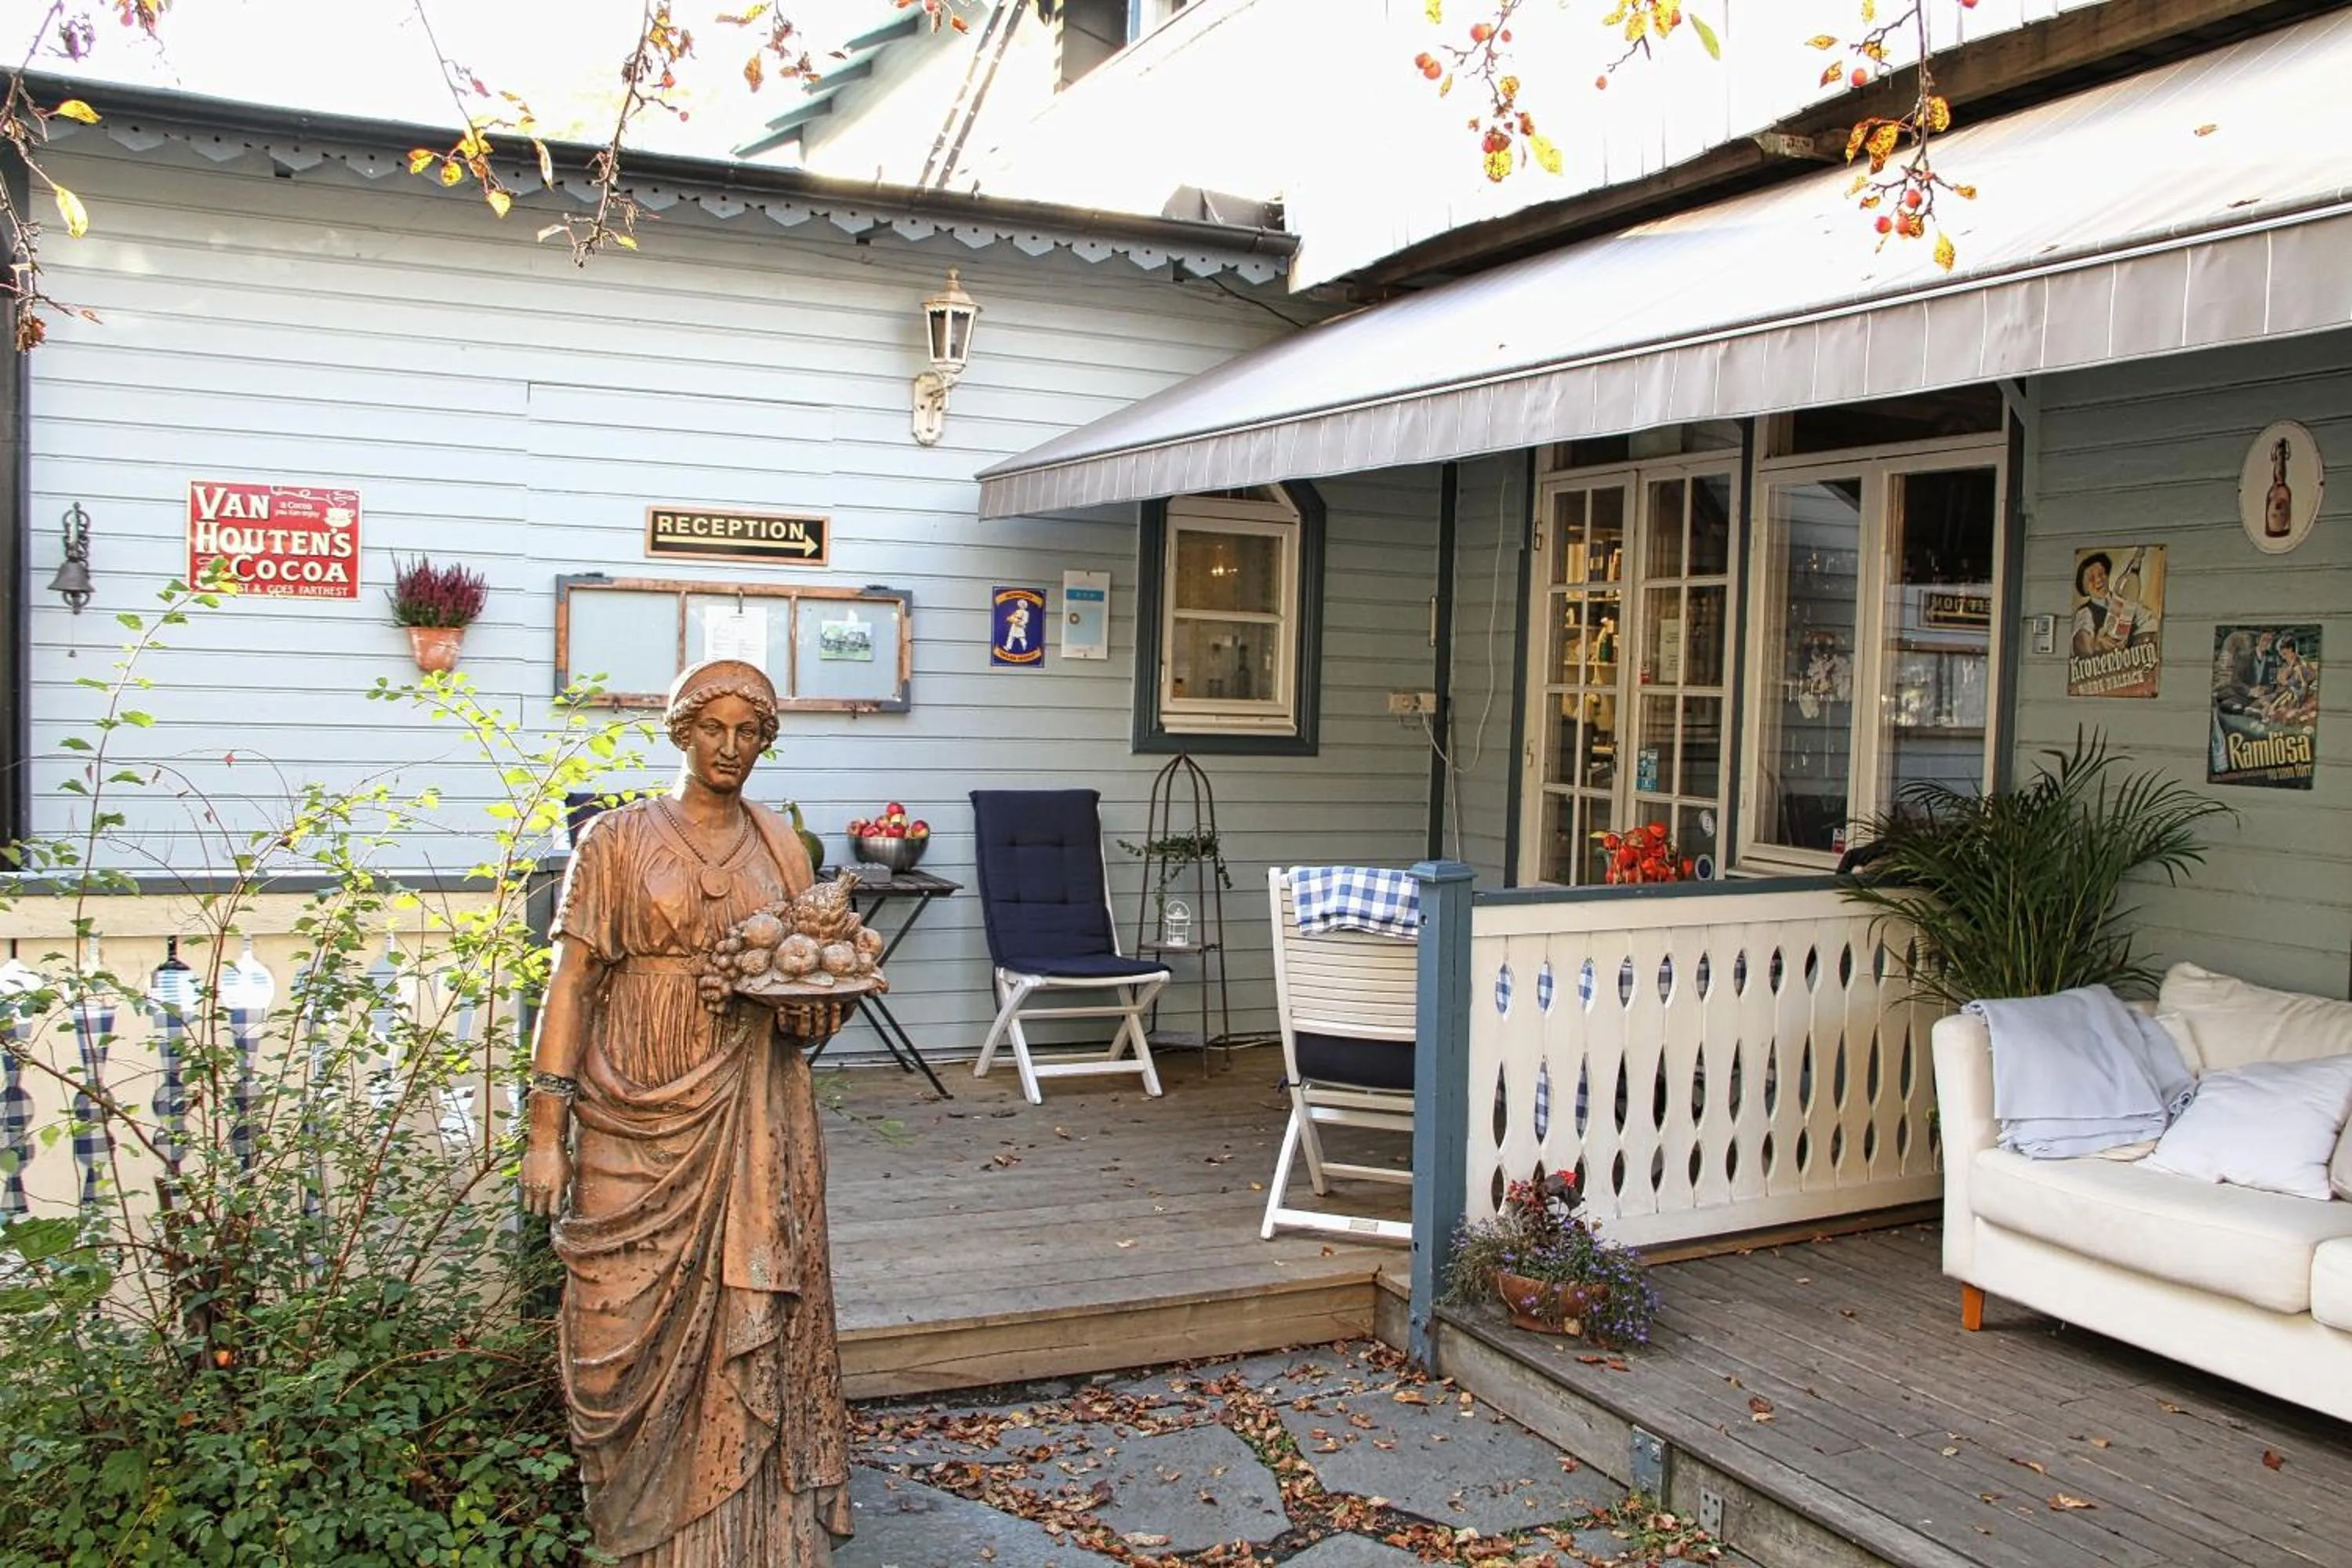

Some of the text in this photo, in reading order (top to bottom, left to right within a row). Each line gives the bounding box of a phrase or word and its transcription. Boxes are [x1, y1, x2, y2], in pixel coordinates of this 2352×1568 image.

[194, 486, 270, 520] VAN
[657, 515, 805, 540] RECEPTION
[230, 554, 350, 583] COCOA
[299, 585, 350, 597] FARTHEST
[2070, 643, 2159, 683] Kronenbourg
[2227, 731, 2311, 770] Ramlösa
